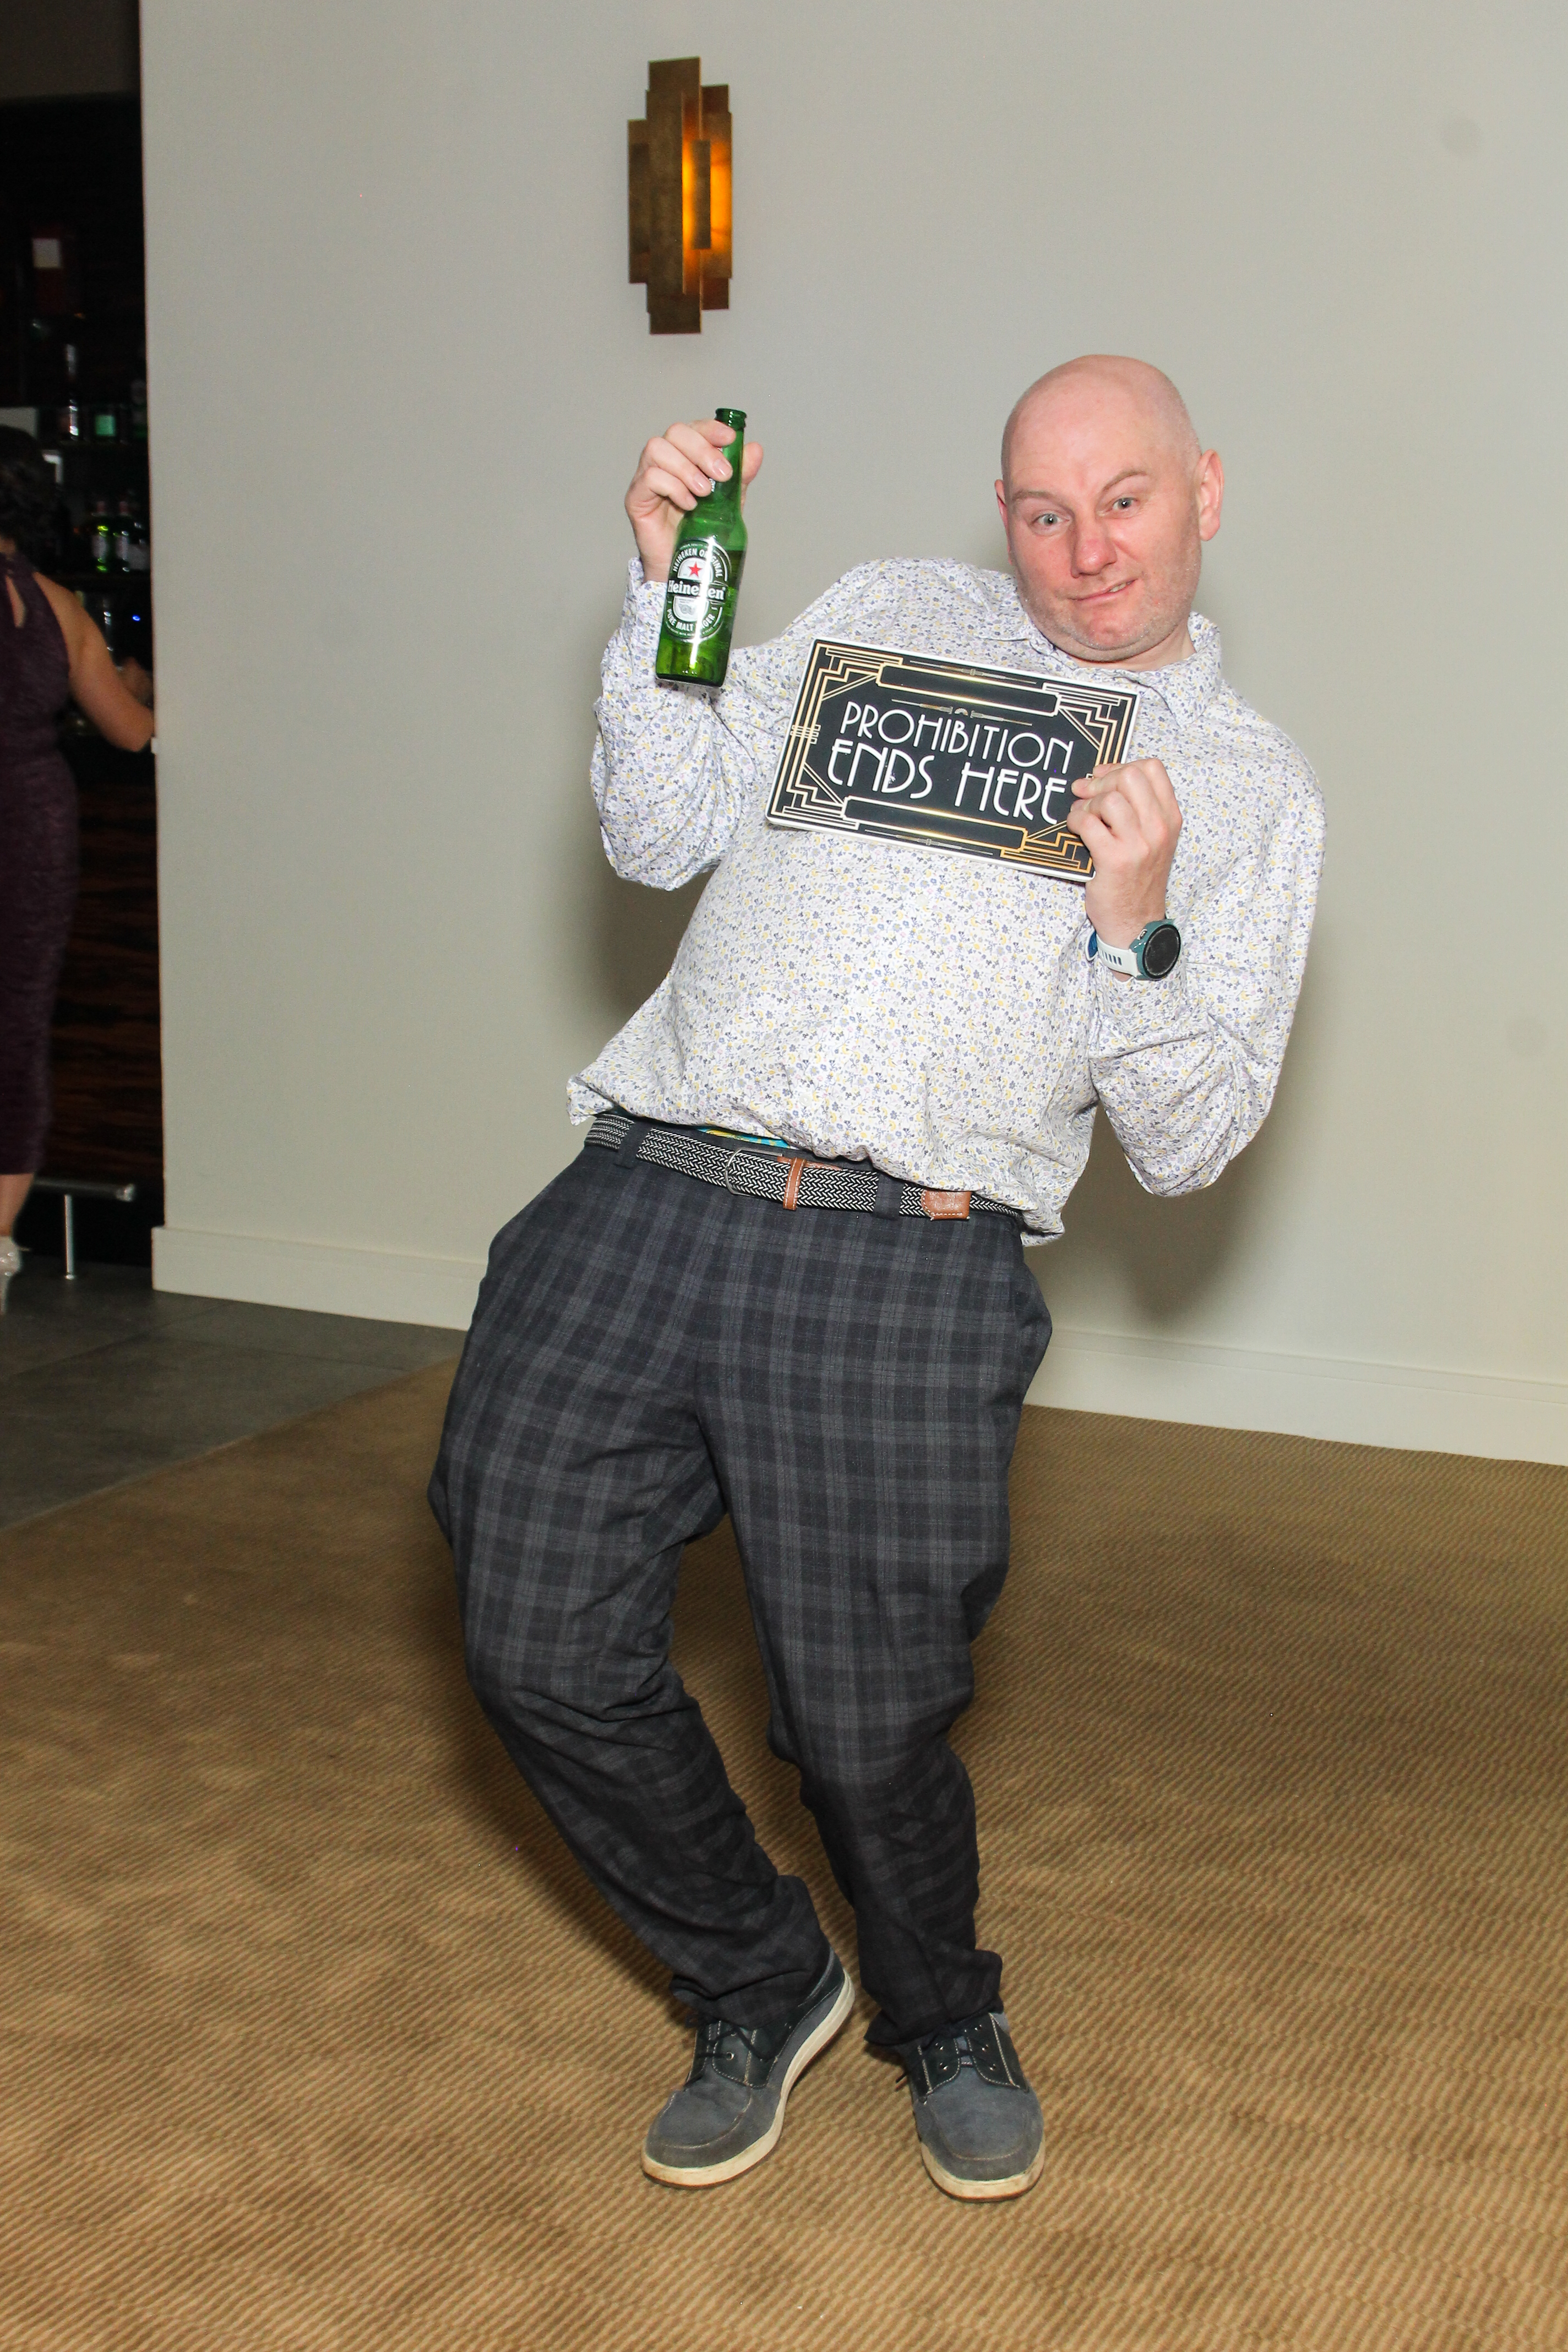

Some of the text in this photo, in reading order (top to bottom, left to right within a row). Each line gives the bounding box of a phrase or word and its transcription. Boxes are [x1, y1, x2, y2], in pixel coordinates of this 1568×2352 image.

[673, 548, 723, 578] HEINEKEN OGINAL
[668, 580, 725, 600] Heineen
[667, 608, 677, 626] PURE
[675, 621, 694, 631] MALT
[698, 613, 716, 630] GER
[840, 701, 1074, 774] PROHIBITION
[827, 738, 1067, 825] ENDS HERE
